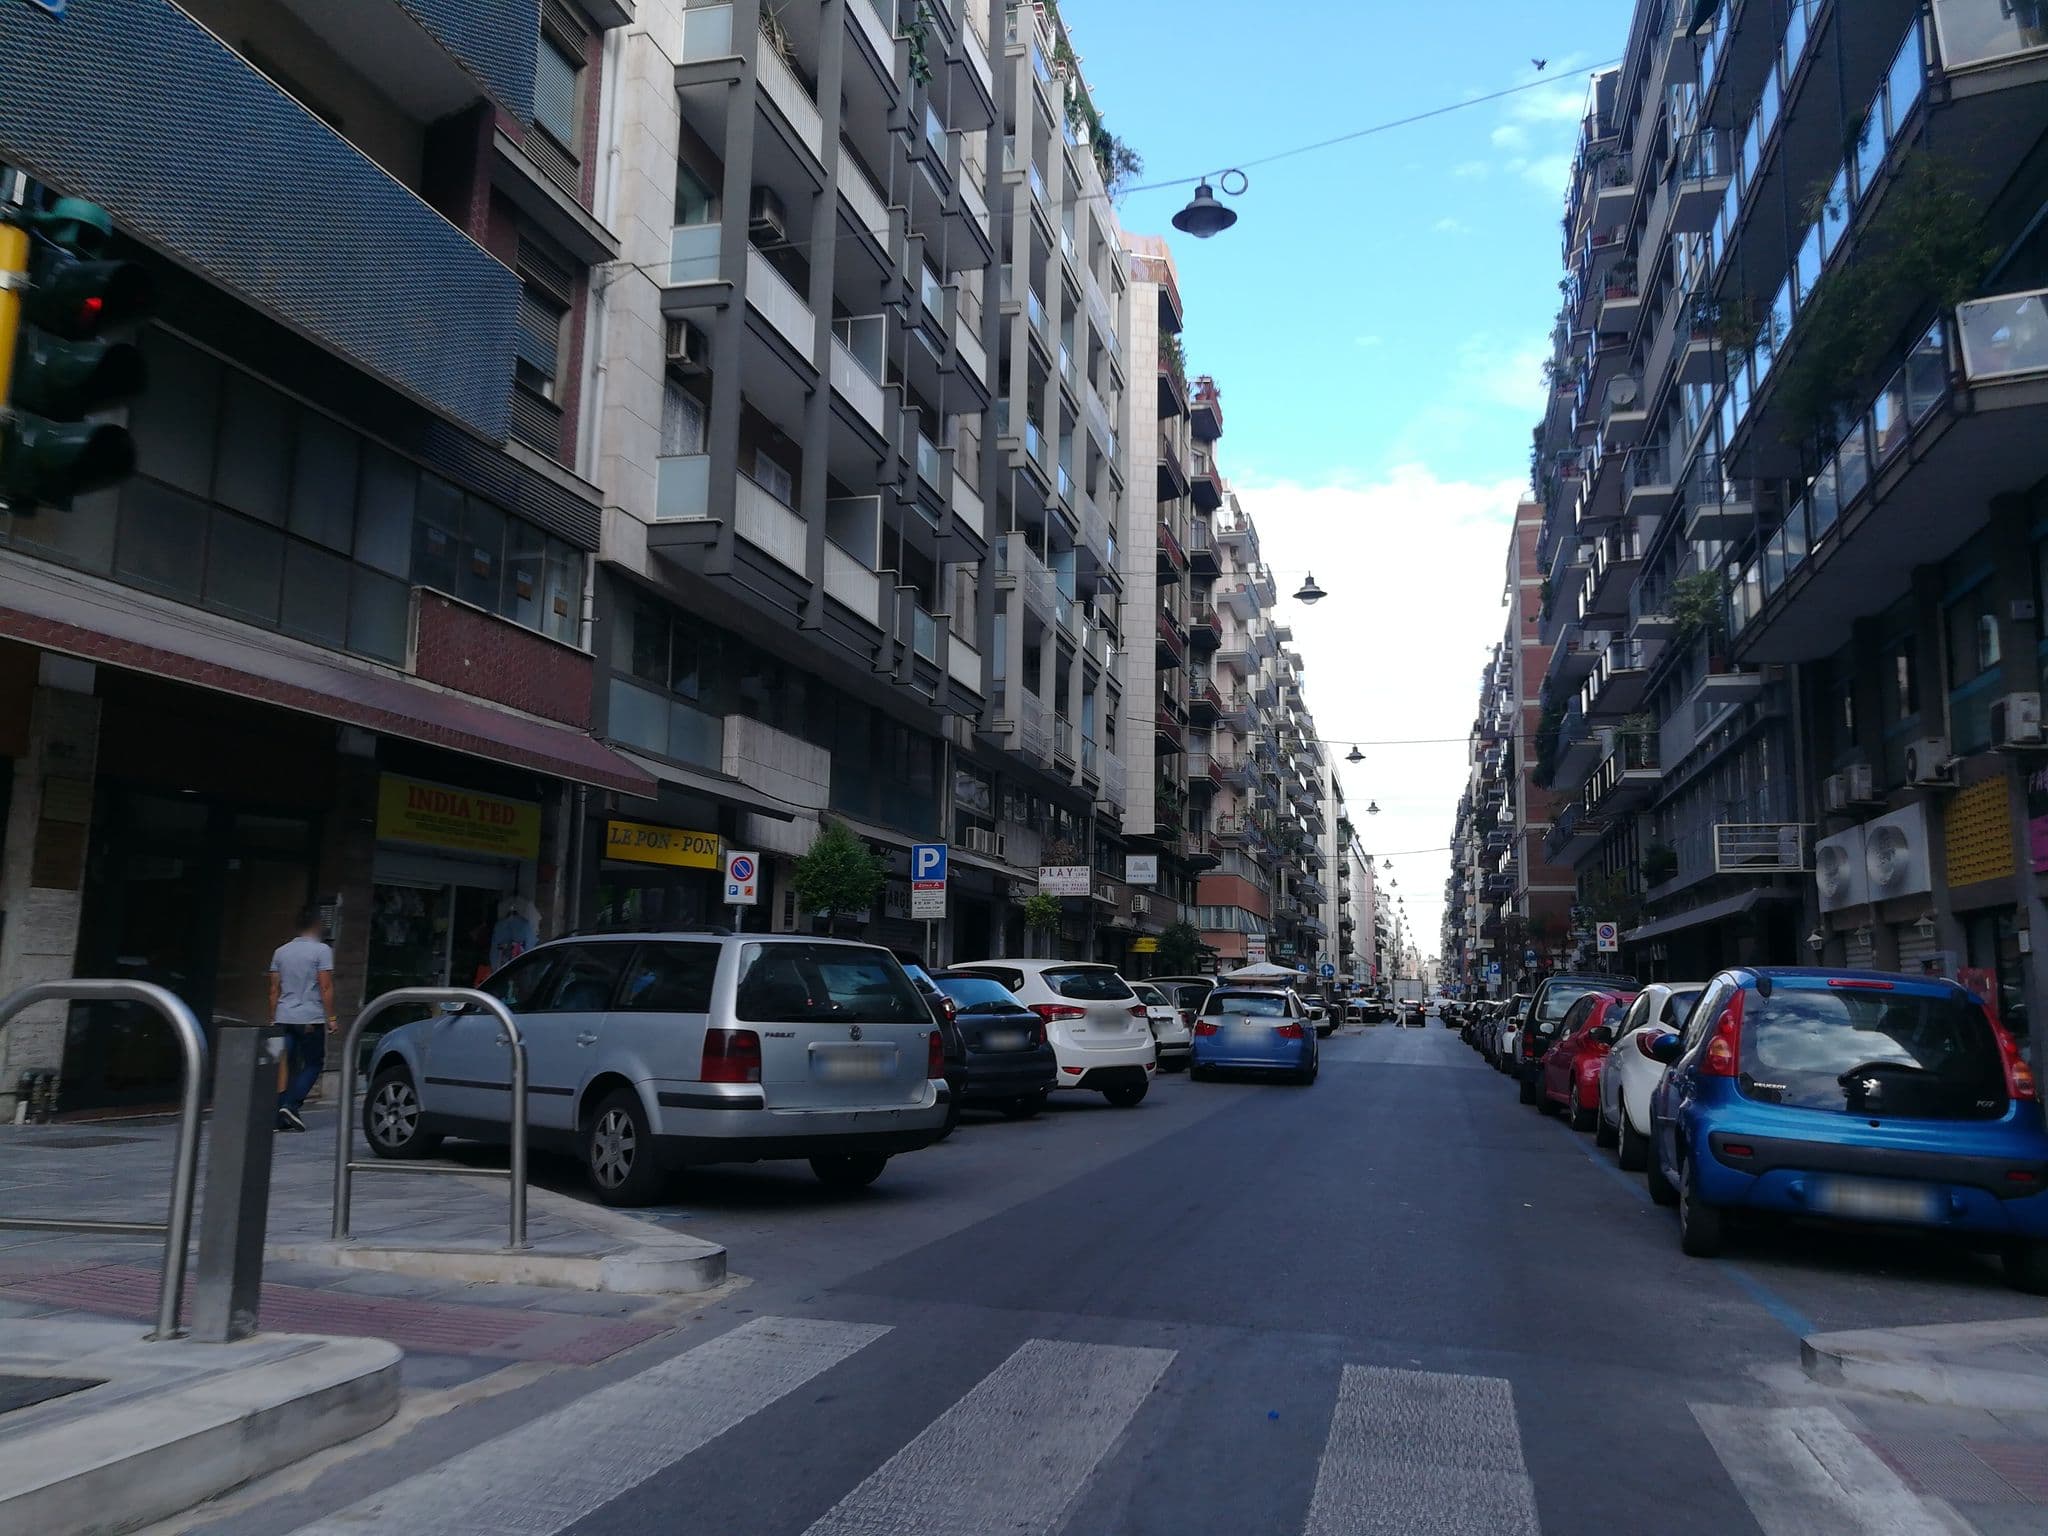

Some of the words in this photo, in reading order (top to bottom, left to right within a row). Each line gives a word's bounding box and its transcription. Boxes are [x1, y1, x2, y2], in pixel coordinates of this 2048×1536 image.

[408, 785, 470, 818] INDIA
[609, 827, 632, 845] LE
[635, 830, 672, 849] PON
[682, 836, 717, 855] PON
[918, 847, 940, 878] P
[1040, 868, 1073, 877] PLAY
[730, 885, 737, 895] P
[1491, 963, 1498, 973] P
